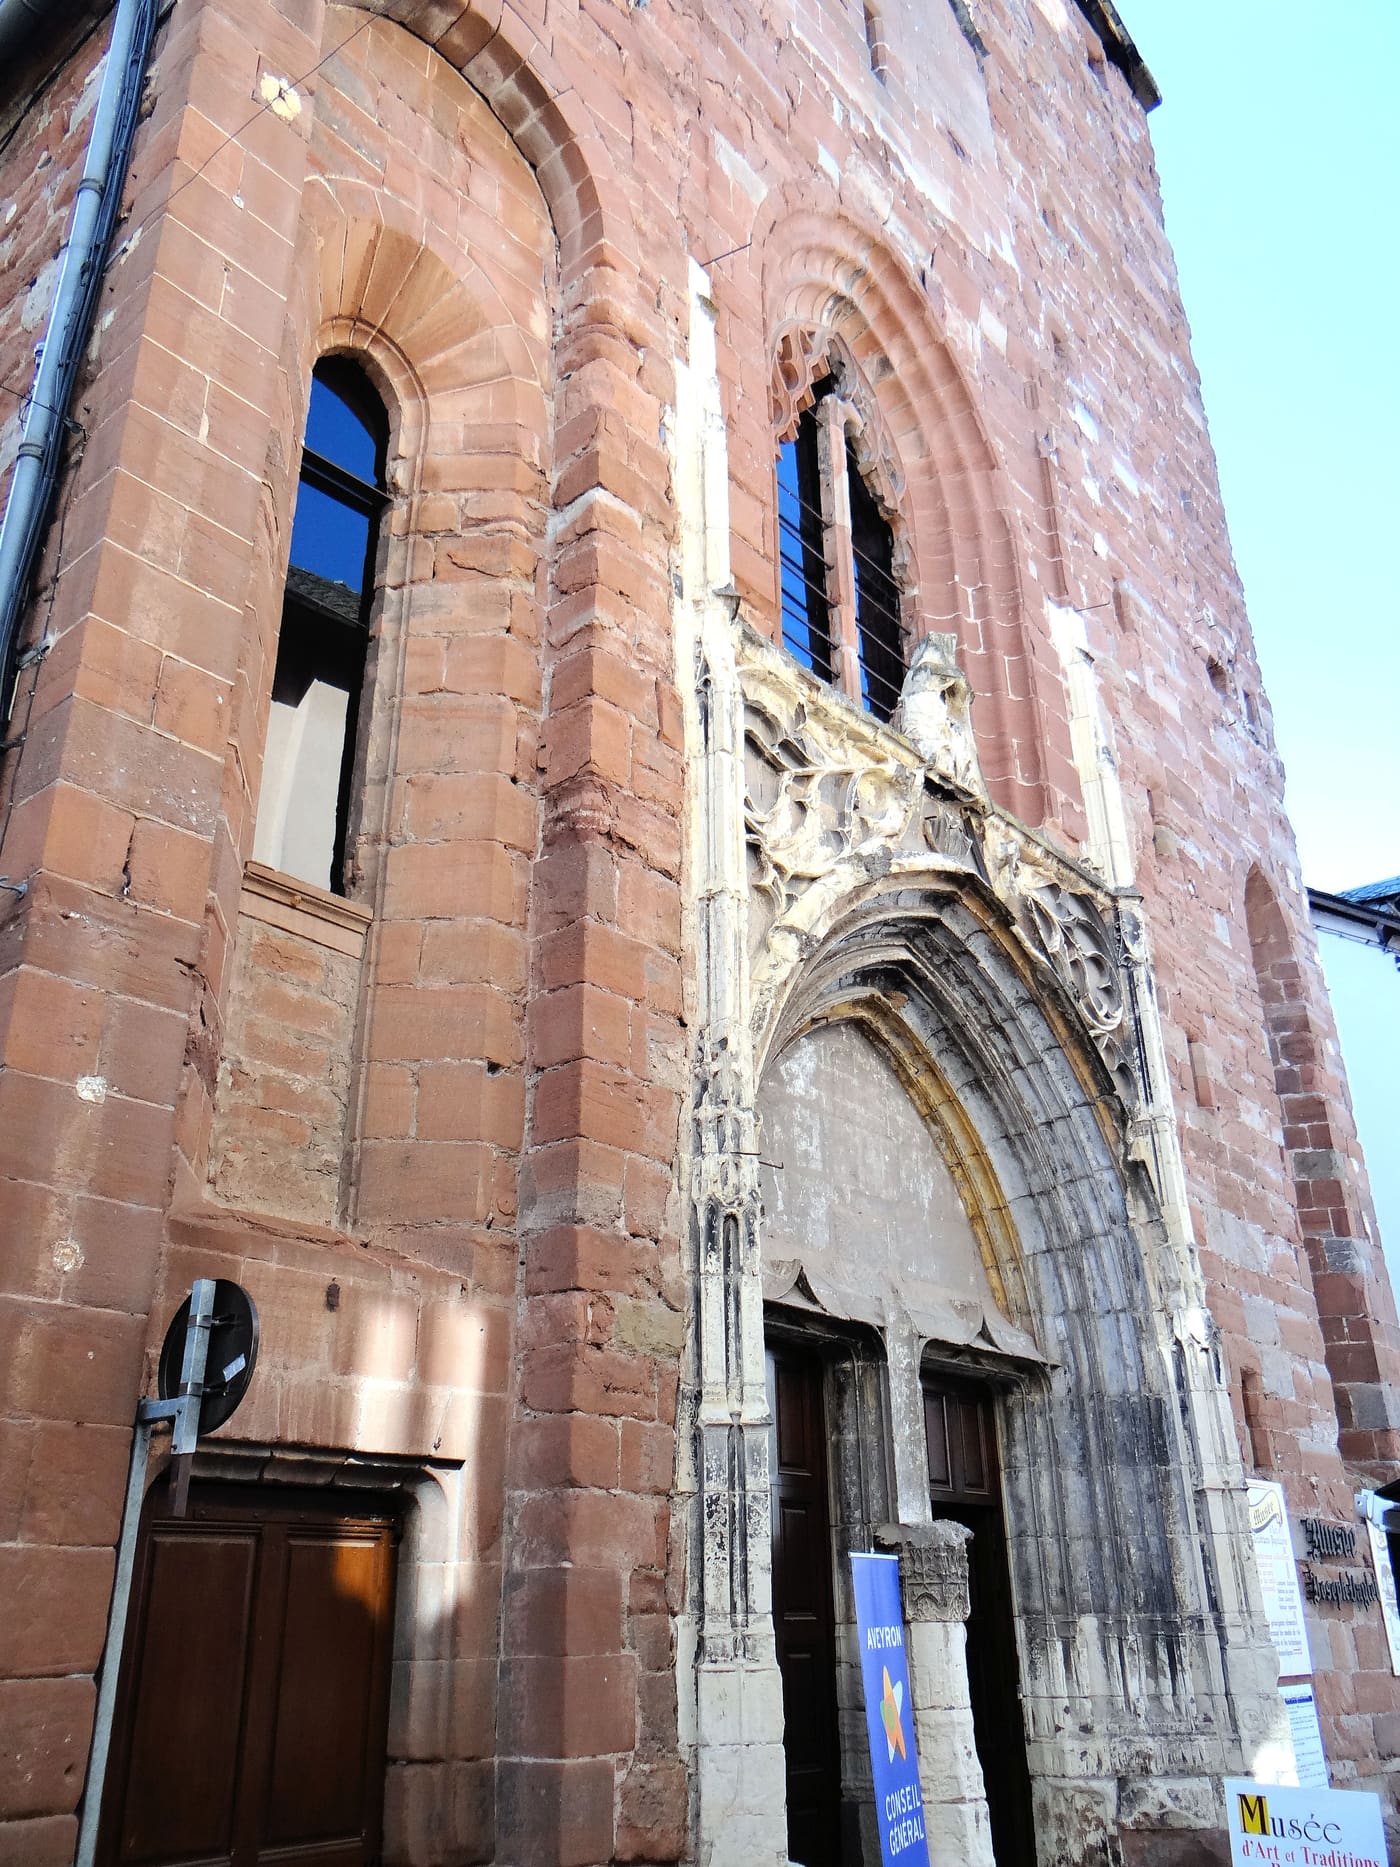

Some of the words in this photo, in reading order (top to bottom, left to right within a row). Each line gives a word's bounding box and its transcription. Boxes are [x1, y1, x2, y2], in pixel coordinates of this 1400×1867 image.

[867, 1625, 902, 1650] AVEYRON
[885, 1783, 921, 1821] CONSEIL
[1236, 1793, 1343, 1845] Musée
[889, 1815, 925, 1857] GÉNÉRAL
[1242, 1839, 1279, 1860] d'Art
[1285, 1851, 1295, 1863] et
[1300, 1846, 1380, 1867] Traditions
